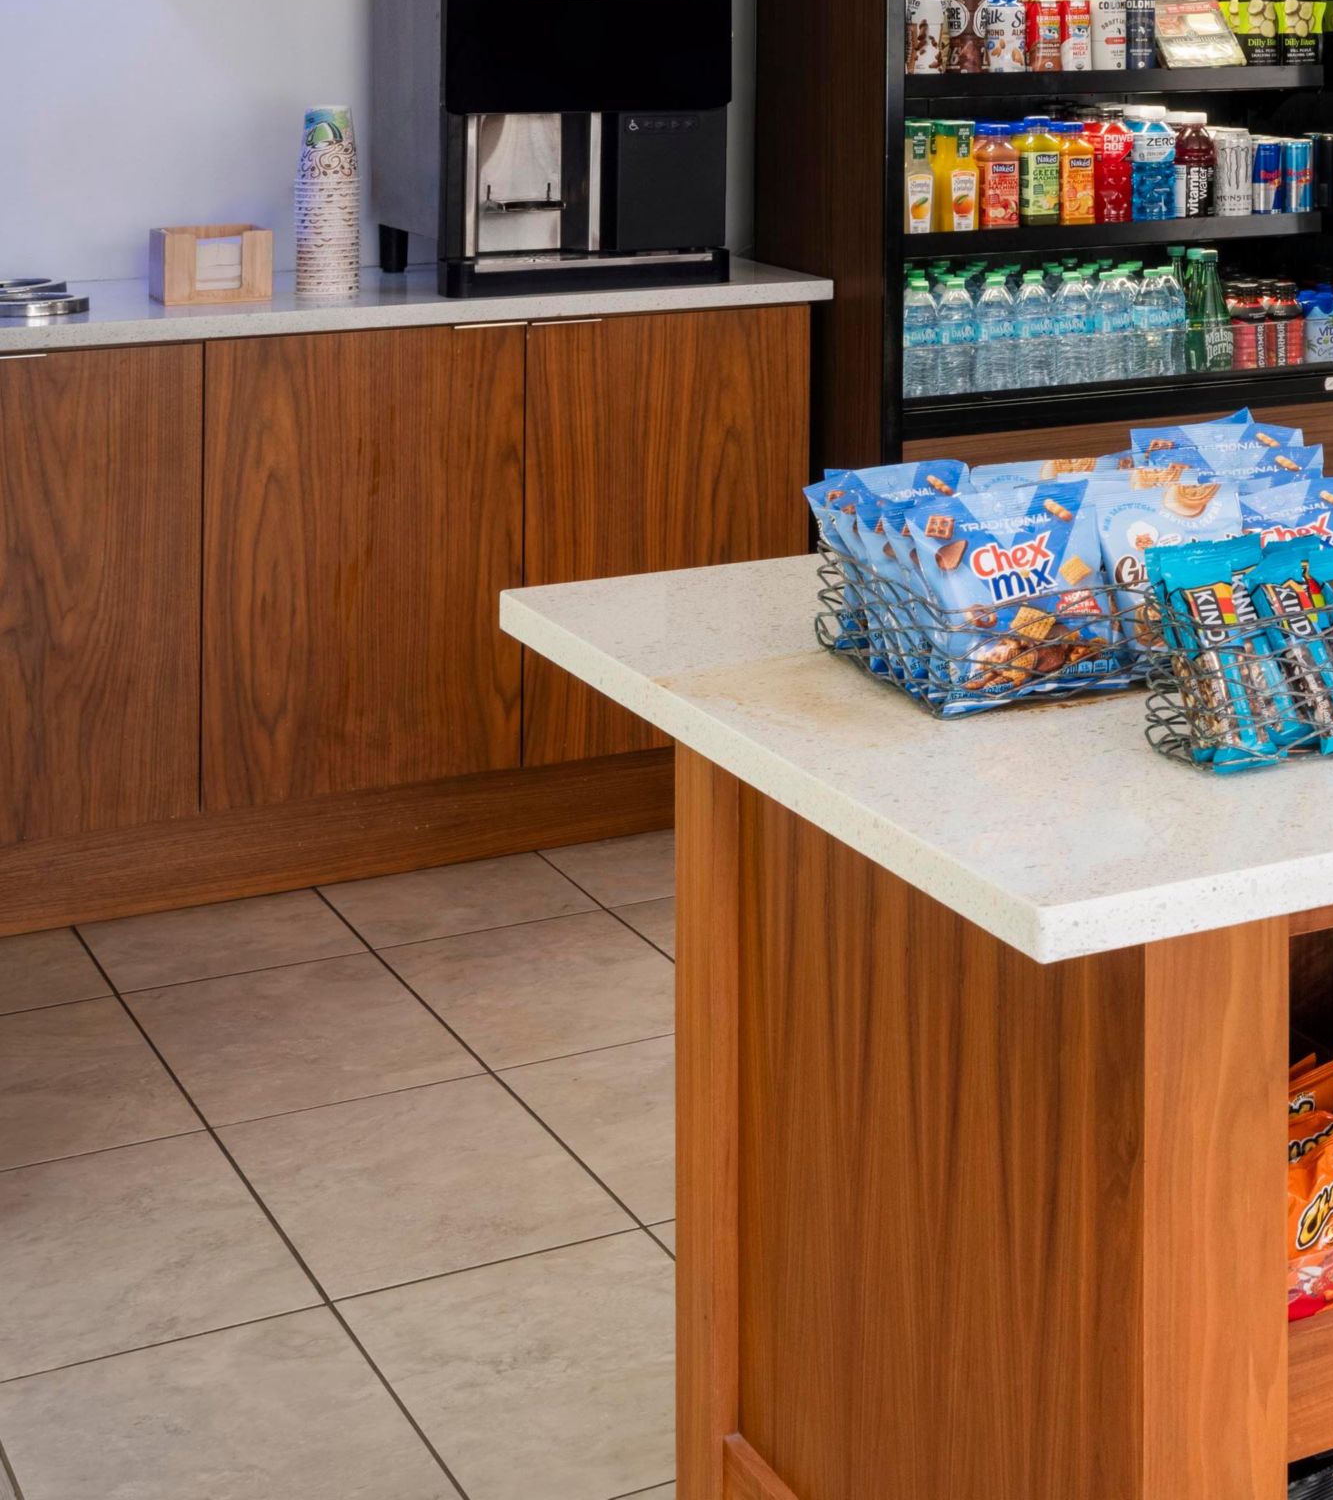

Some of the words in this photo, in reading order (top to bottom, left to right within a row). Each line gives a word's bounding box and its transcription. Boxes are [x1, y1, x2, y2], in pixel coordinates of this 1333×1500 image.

[1146, 137, 1174, 147] ZERO
[1037, 155, 1058, 163] Naked
[1070, 158, 1092, 167] Naked
[993, 164, 1014, 173] Naked
[1189, 167, 1200, 216] vitamin
[960, 512, 1051, 532] TRADITIONAL
[973, 534, 1051, 576] Chex
[1195, 591, 1227, 642] KIND
